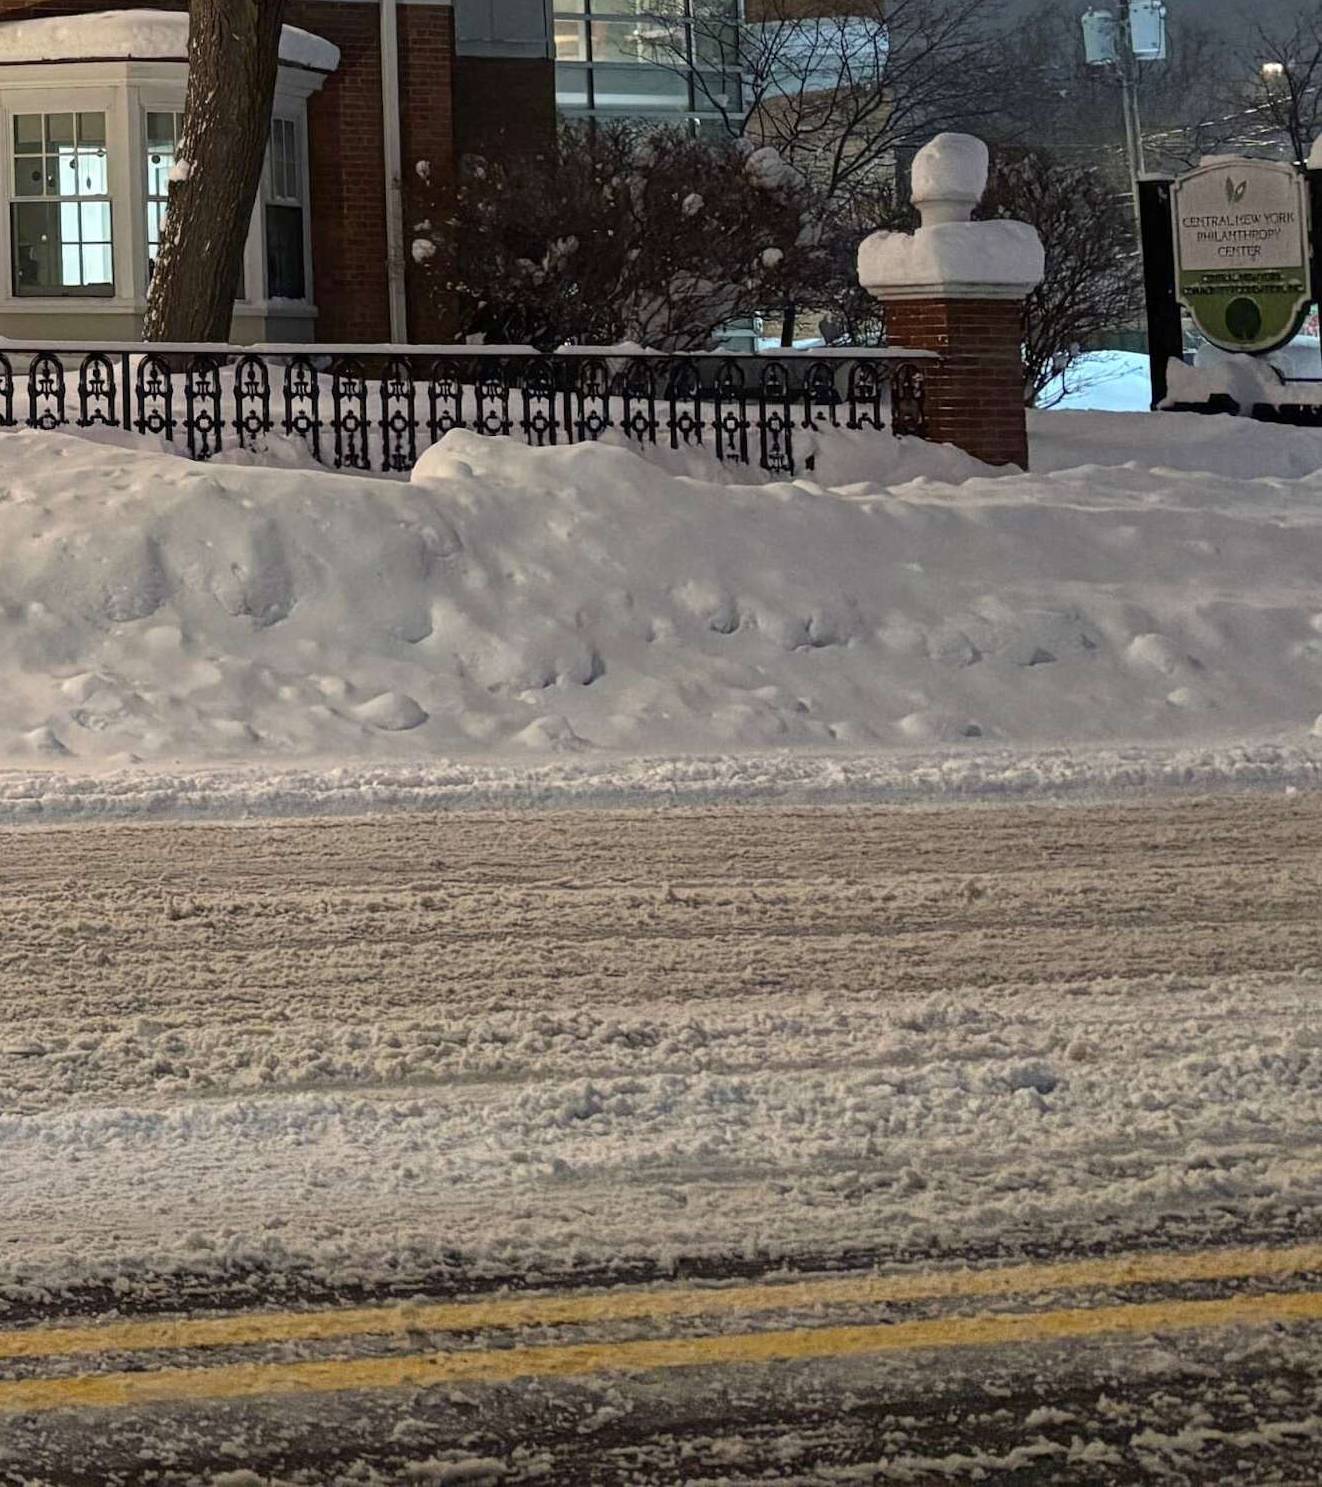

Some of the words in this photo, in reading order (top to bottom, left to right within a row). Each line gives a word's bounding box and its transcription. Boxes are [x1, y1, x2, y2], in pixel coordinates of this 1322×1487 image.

[1182, 215, 1234, 228] CENTRAL
[1264, 212, 1295, 224] YORK
[1218, 245, 1261, 257] CENTER
